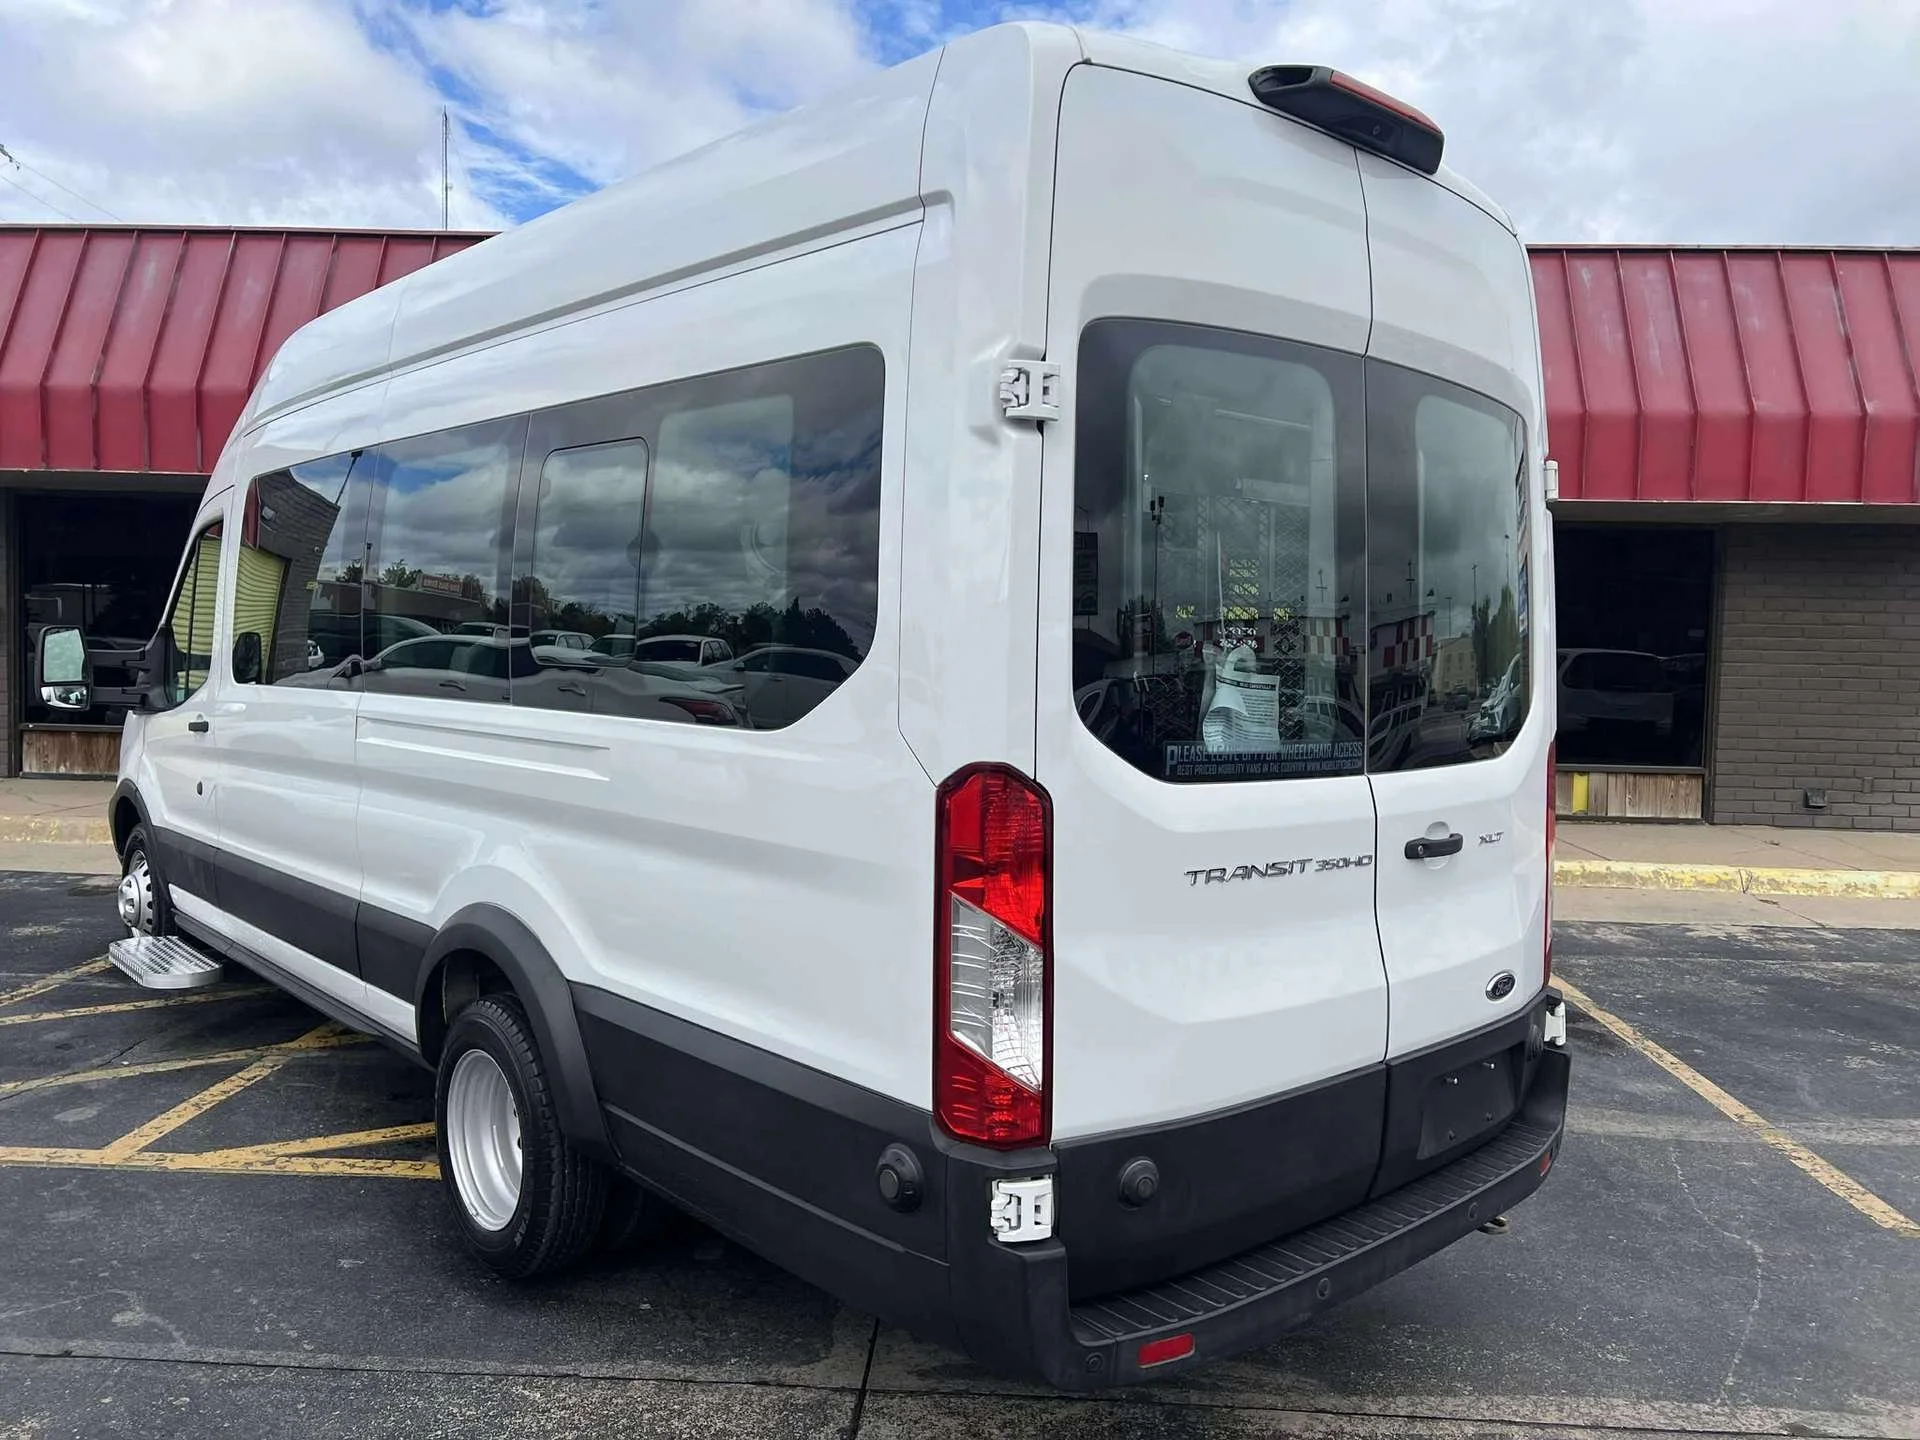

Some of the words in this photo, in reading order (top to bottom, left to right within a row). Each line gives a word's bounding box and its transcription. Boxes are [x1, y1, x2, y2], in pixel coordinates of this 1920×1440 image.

[1166, 744, 1208, 776] PLEASE
[1280, 743, 1332, 760] WHEELCHAIR
[1333, 742, 1362, 757] ACCESS
[1176, 763, 1193, 776] BEST
[1218, 762, 1244, 775] MOBILITY
[1245, 762, 1261, 773] VANS
[1479, 831, 1504, 846] XLT
[1184, 858, 1313, 886] TRANSIT
[1315, 854, 1373, 872] 350HD
